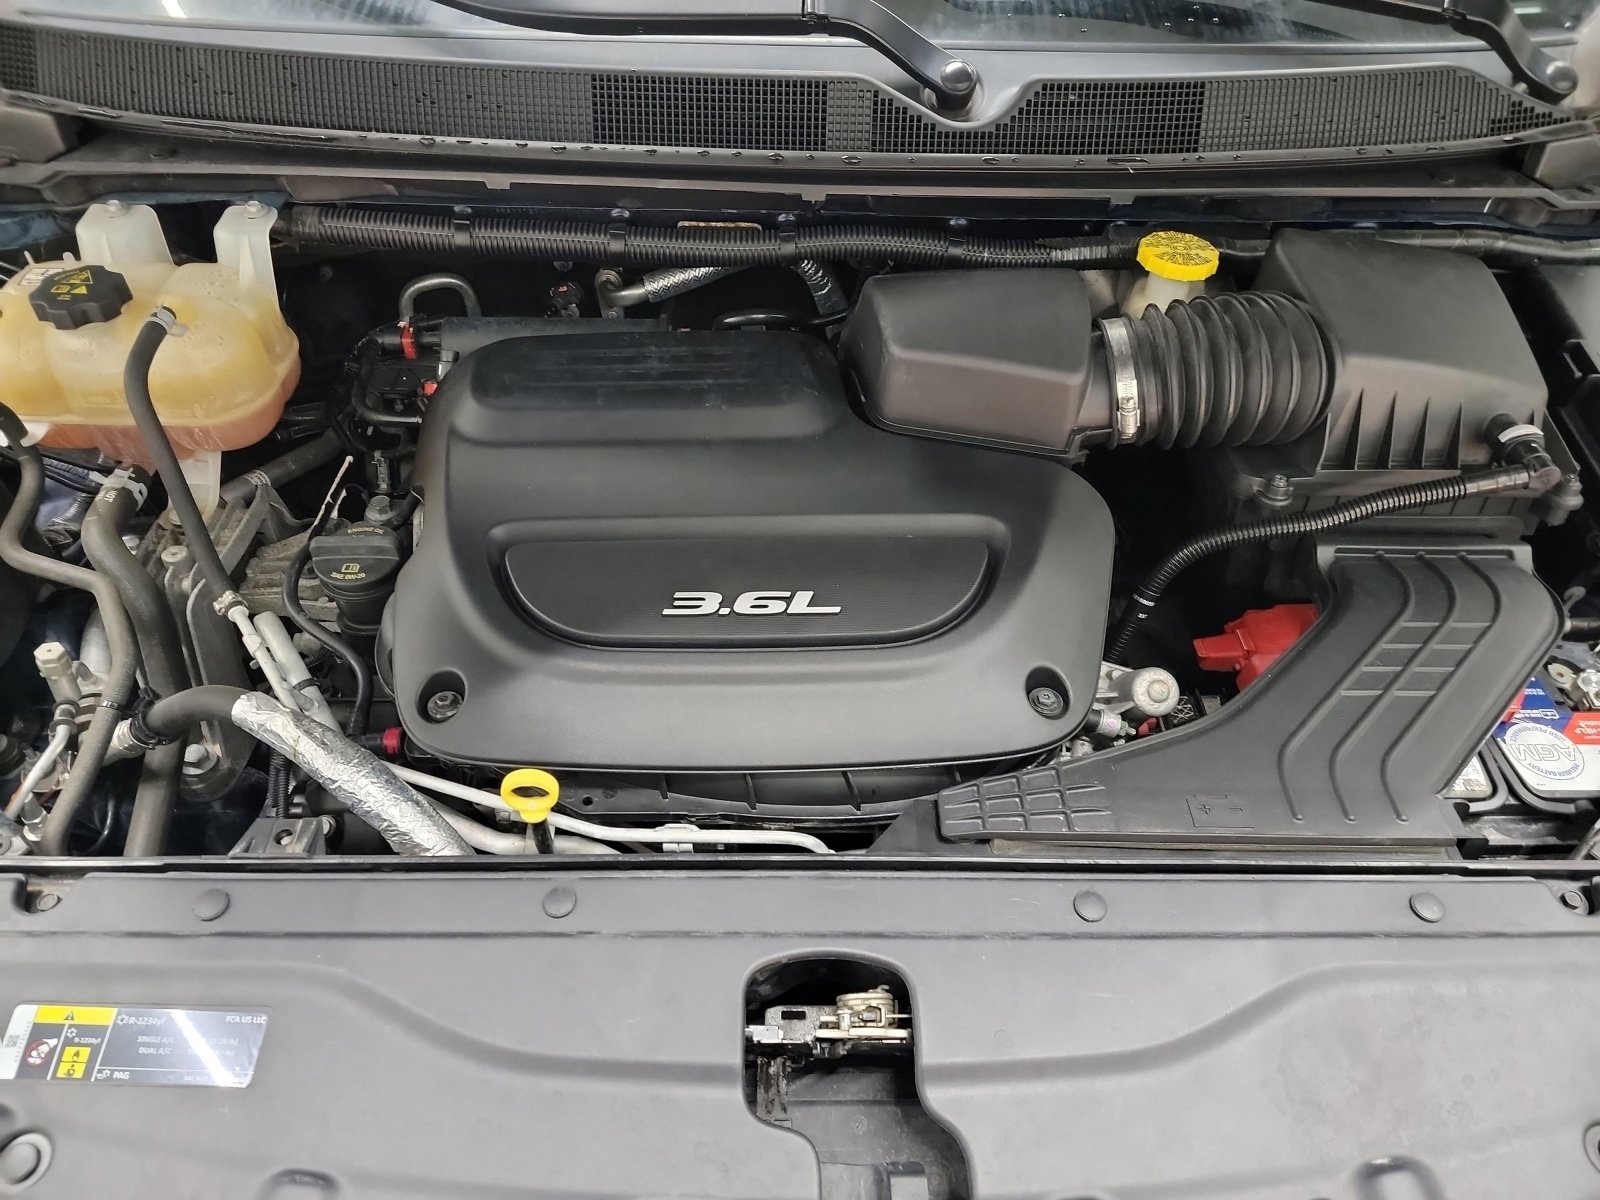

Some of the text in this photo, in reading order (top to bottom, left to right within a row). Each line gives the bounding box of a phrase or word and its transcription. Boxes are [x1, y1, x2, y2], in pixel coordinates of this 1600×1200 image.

[661, 590, 842, 615] 3.6L
[1509, 743, 1577, 762] AGM
[1526, 762, 1558, 777] BATTERY
[225, 1015, 266, 1025] FCA US LLC
[136, 1035, 161, 1044] SINGLE
